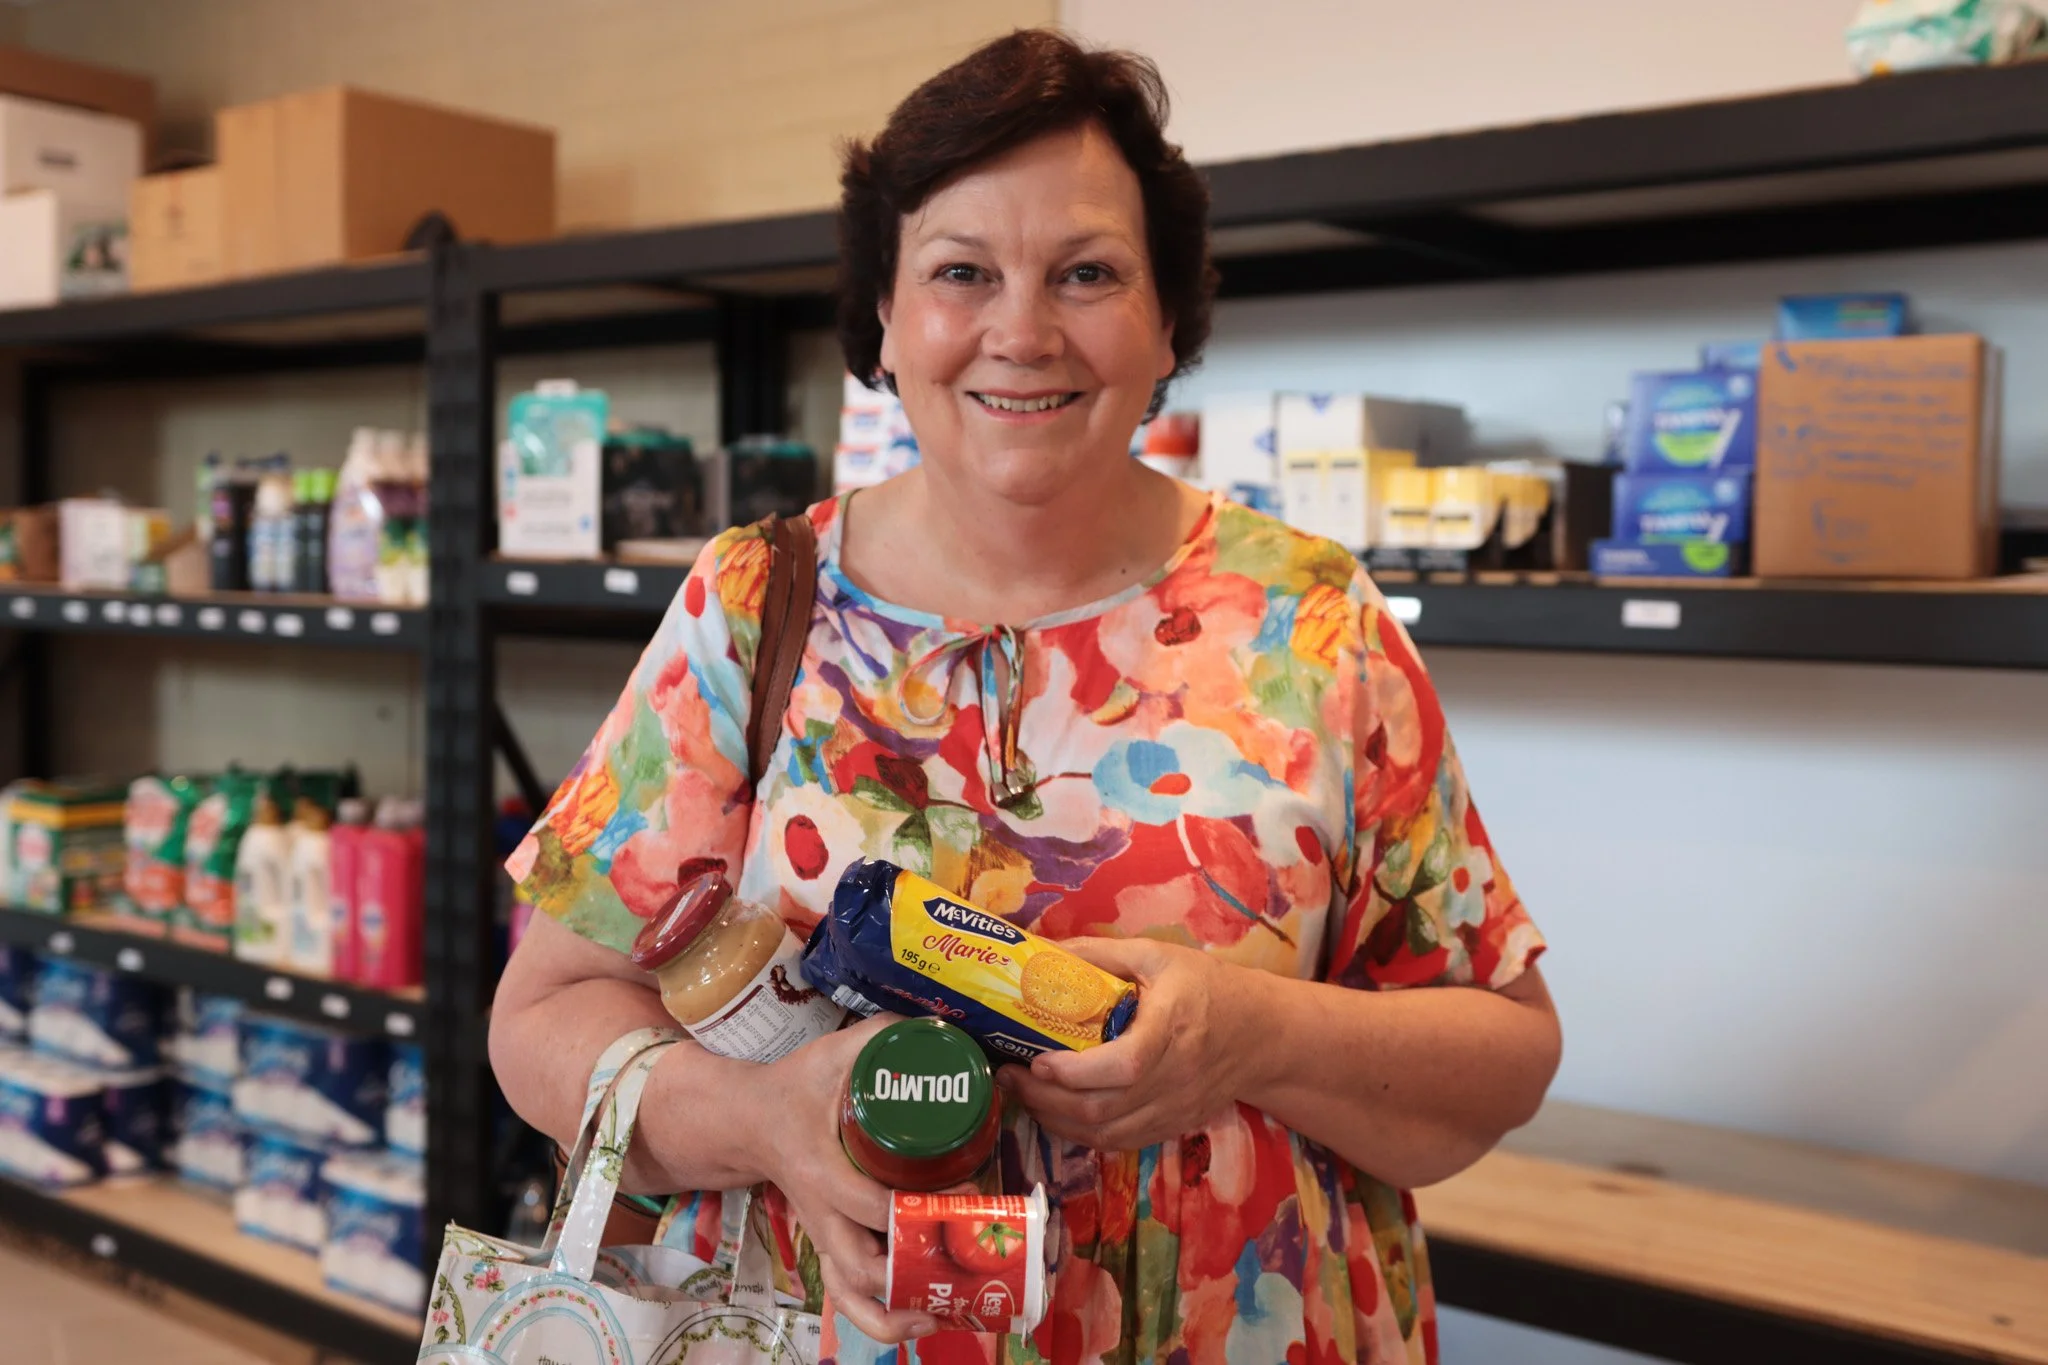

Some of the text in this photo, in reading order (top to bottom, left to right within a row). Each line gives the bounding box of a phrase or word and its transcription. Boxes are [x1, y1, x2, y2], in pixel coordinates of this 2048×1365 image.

[933, 902, 1016, 939] McVitie's
[901, 948, 920, 964] 195
[923, 934, 1000, 965] Marie
[927, 1283, 953, 1316] PAS
